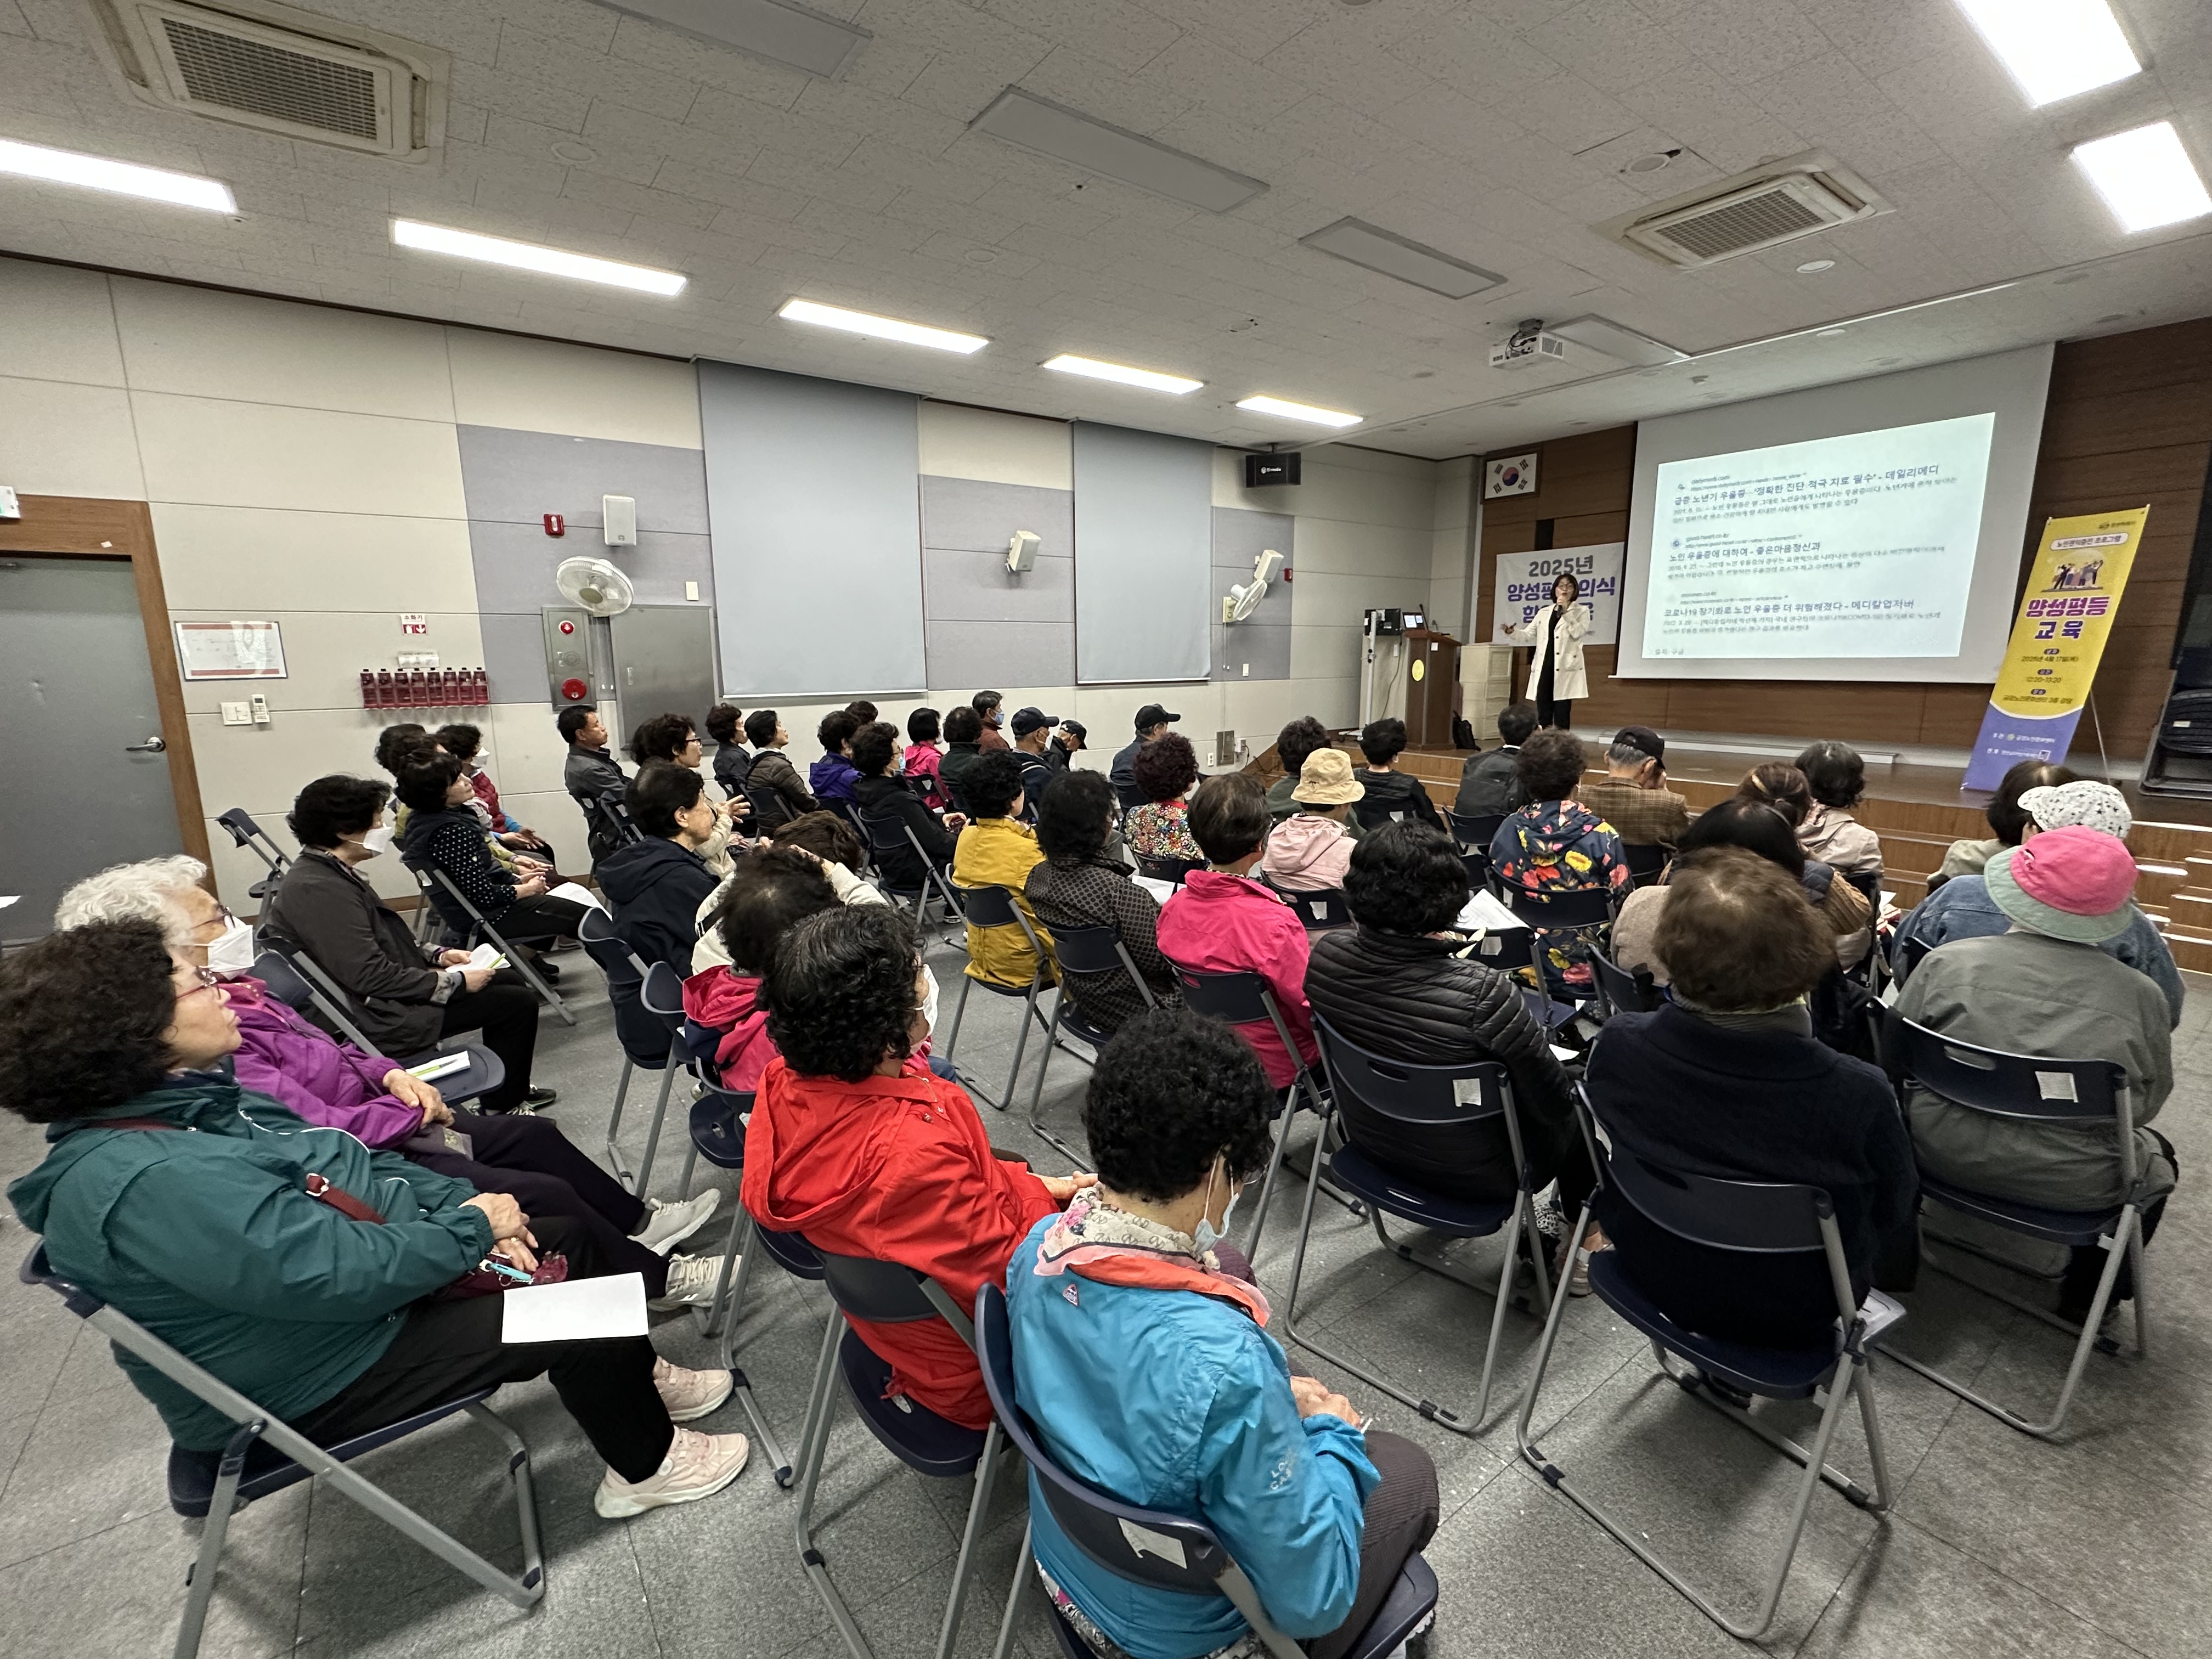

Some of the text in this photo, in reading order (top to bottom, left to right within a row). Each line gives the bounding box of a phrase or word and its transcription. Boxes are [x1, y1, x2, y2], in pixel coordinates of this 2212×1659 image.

[1692, 492, 1717, 504] 노년기
[1786, 481, 1804, 492] 진단
[1807, 478, 1827, 490] 적극
[1884, 464, 1939, 481] 데일리메디
[1669, 552, 1685, 562] 노인
[1722, 548, 1747, 557] 대하여
[1528, 555, 1593, 577] 2025년
[1664, 607, 1697, 617] 코로나19
[1734, 605, 1751, 614] 노인
[1783, 603, 1792, 613] 더
[2026, 596, 2110, 617] 양성평등
